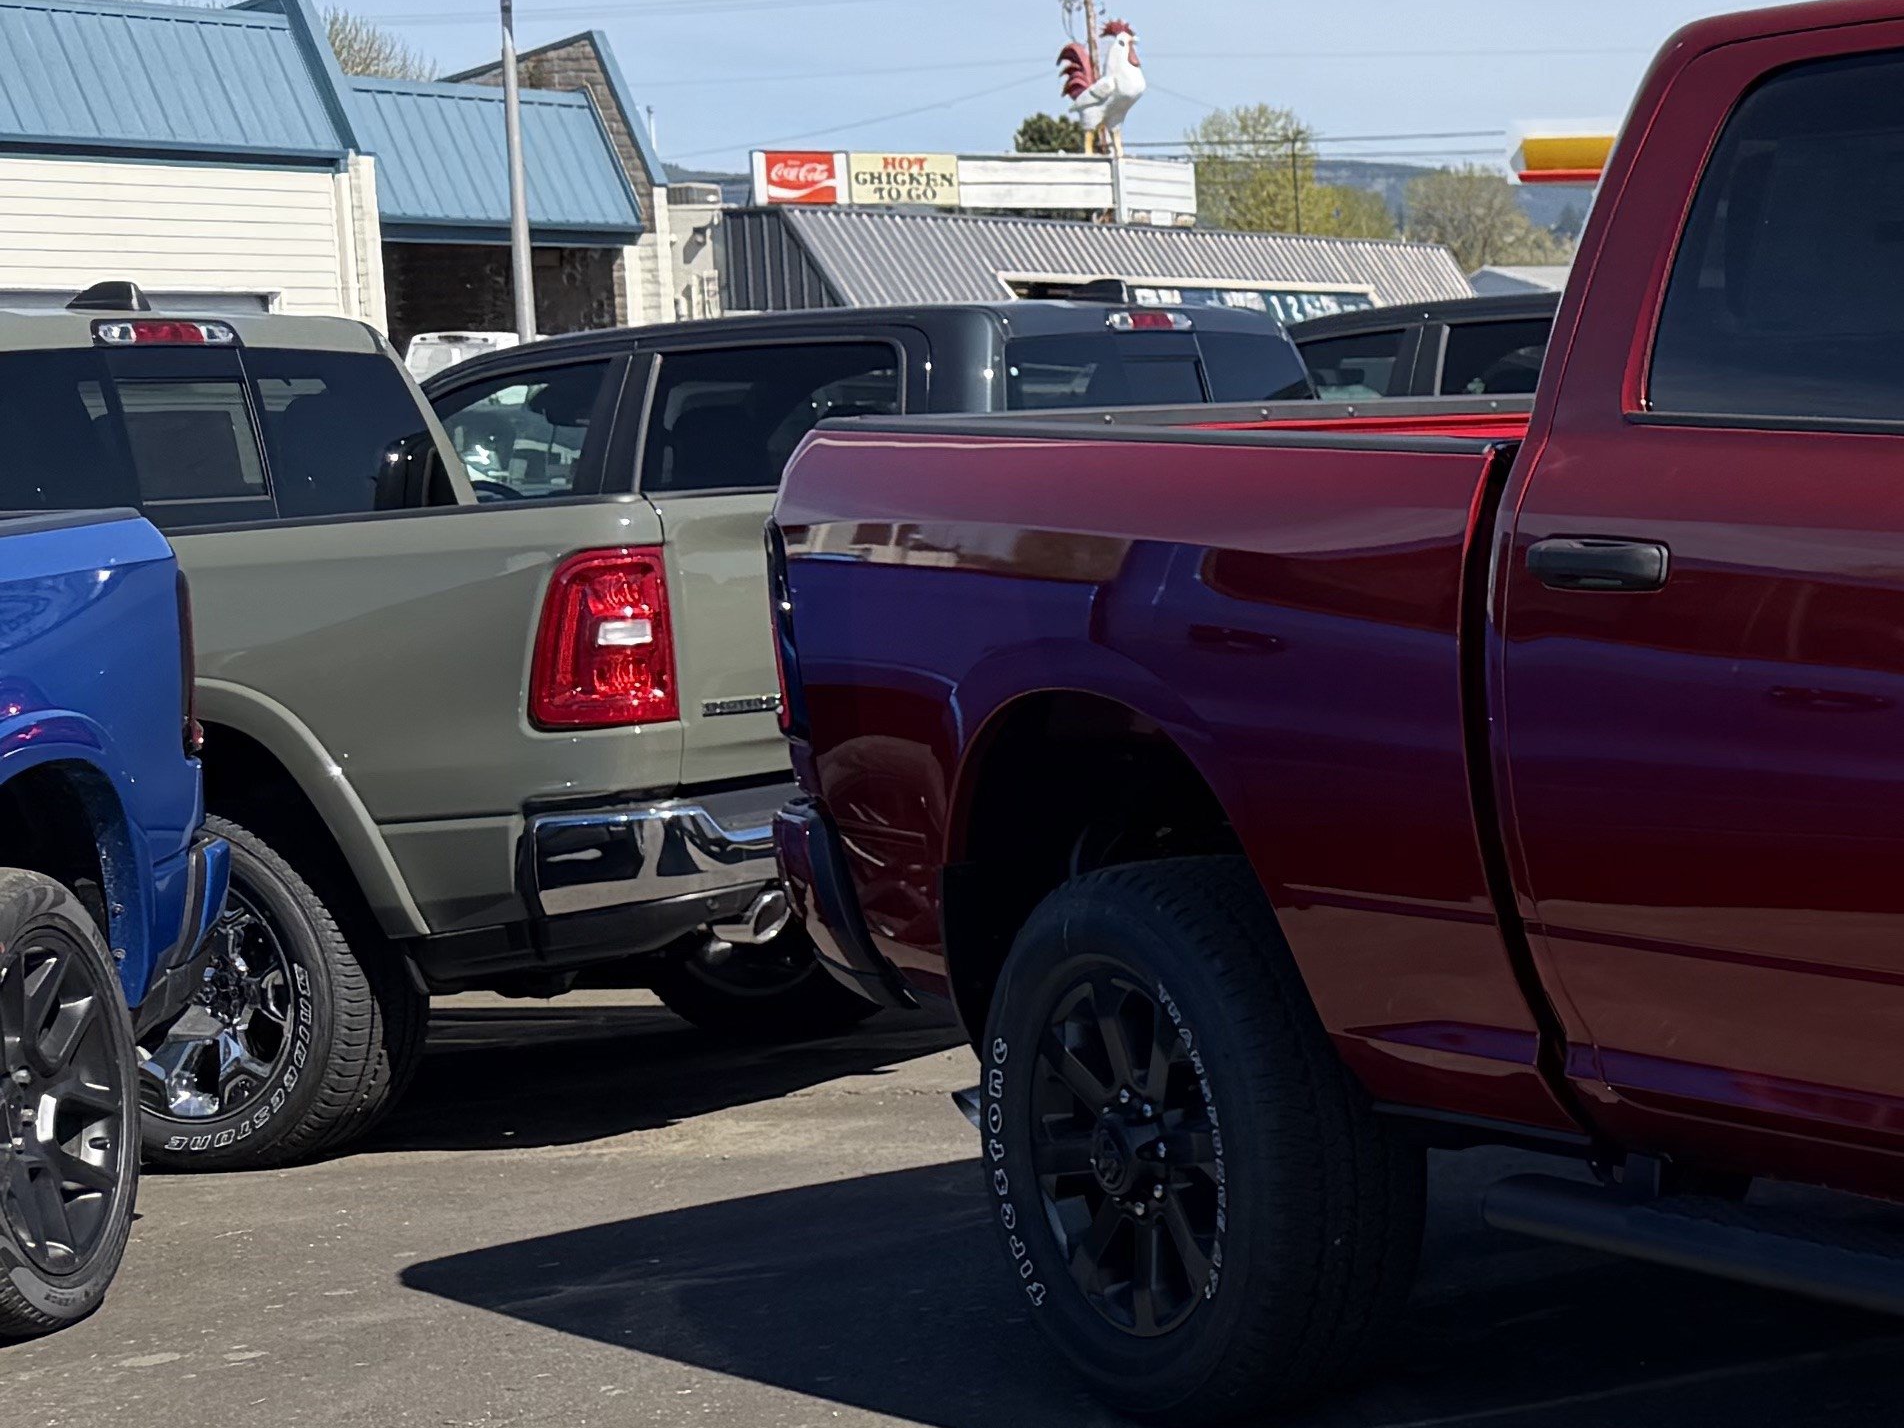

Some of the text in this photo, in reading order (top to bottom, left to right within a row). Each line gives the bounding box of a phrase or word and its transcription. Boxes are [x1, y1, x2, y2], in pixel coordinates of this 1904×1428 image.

[882, 156, 928, 172] HOT
[854, 171, 955, 188] CHICKEN
[873, 186, 938, 201] TO GO
